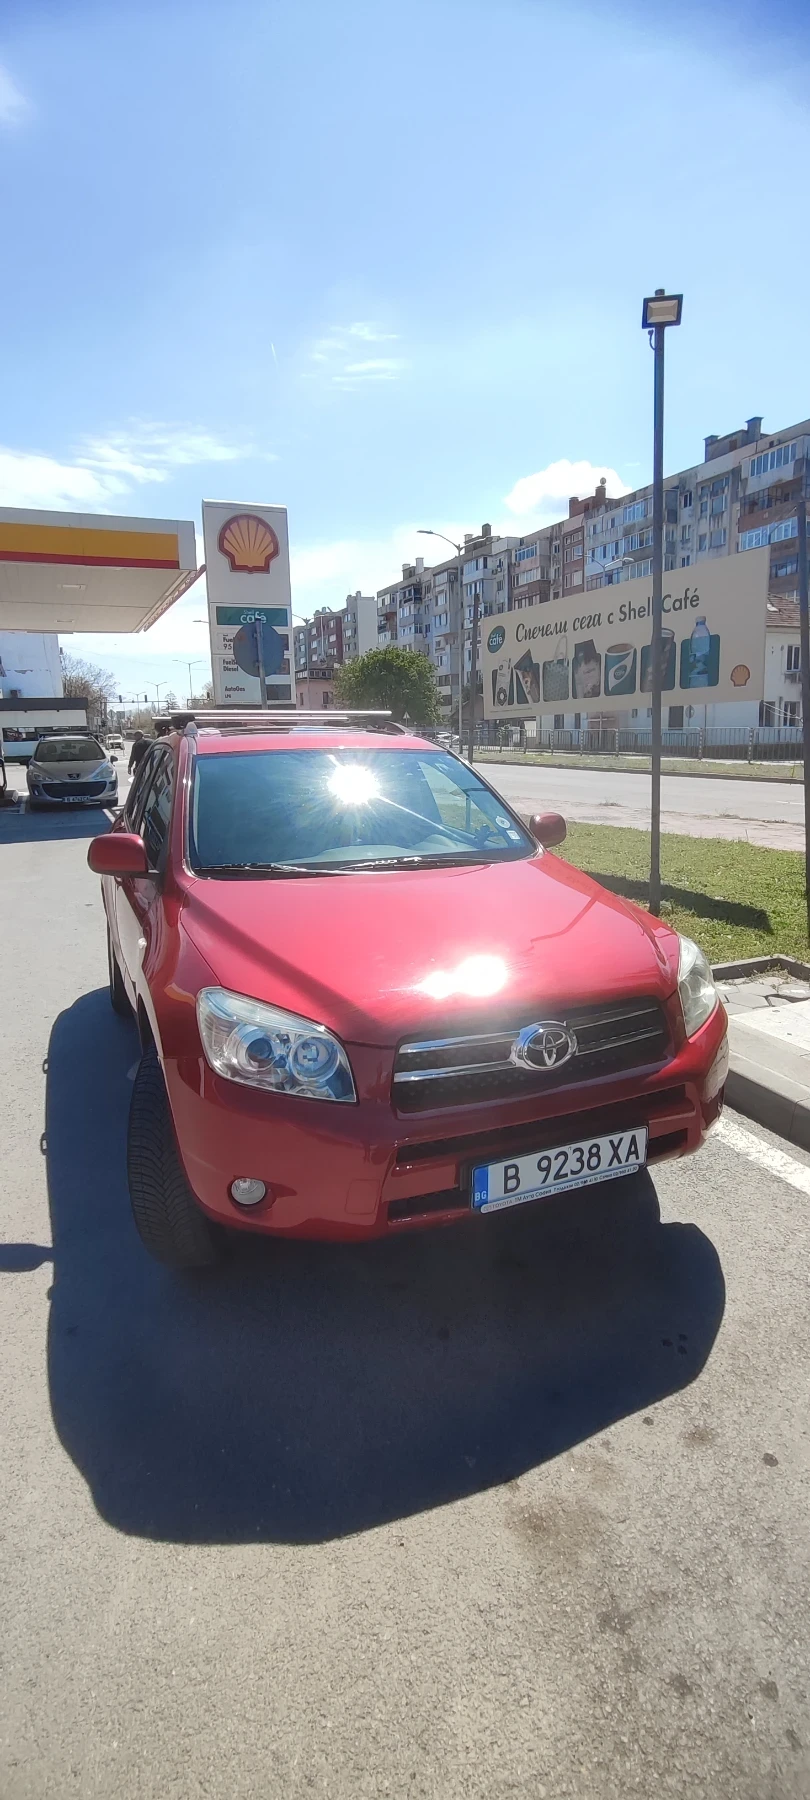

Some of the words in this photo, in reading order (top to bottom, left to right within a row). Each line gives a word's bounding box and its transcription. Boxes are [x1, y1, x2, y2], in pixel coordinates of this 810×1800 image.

[515, 620, 568, 642] Спечели
[572, 612, 602, 631] сега
[661, 587, 700, 613] Café
[503, 1163, 521, 1195] B
[536, 1143, 601, 1185] 9238
[607, 1134, 640, 1168] XA
[474, 1190, 487, 1201] BG
